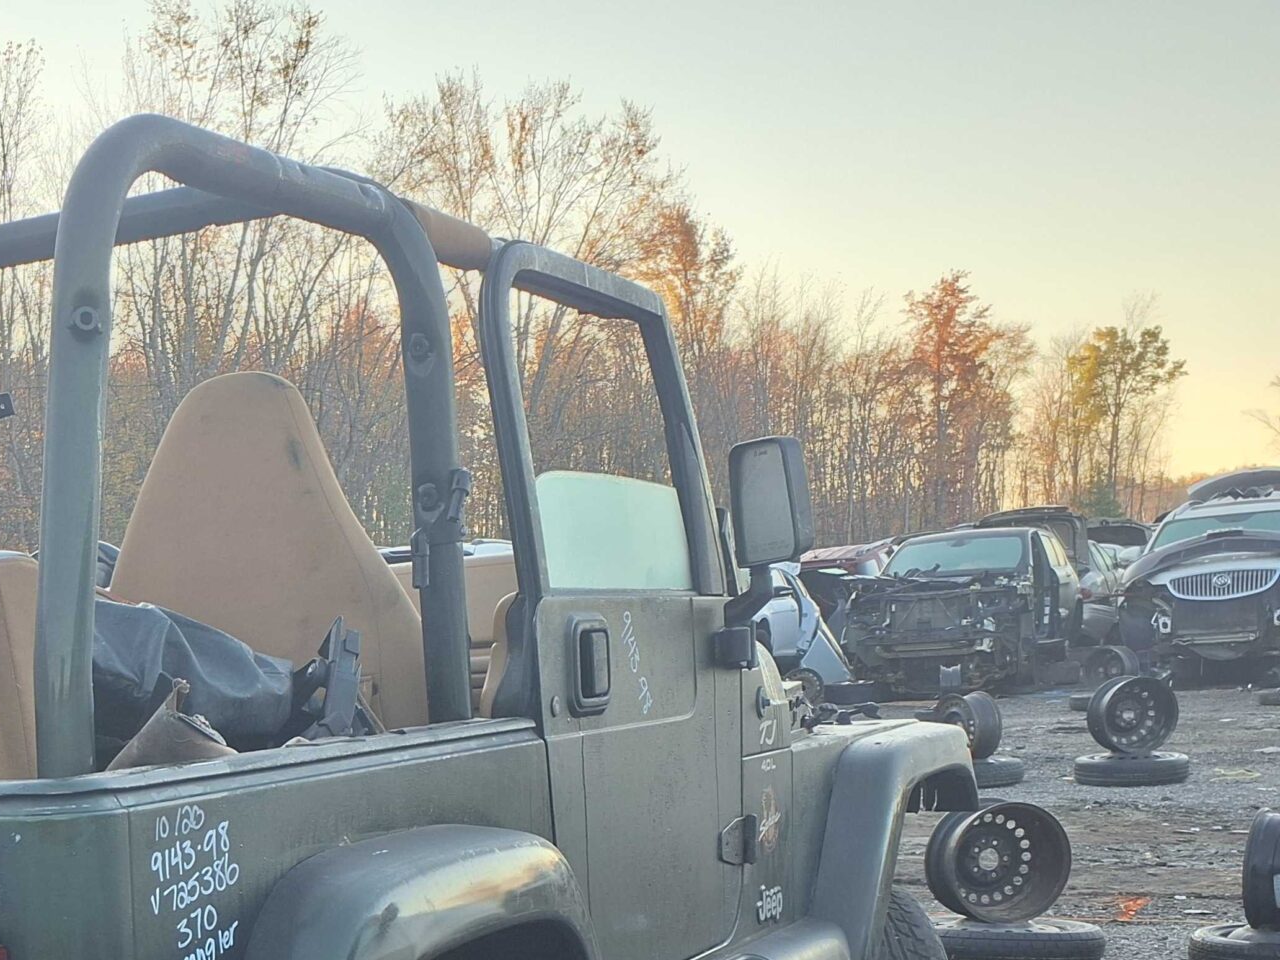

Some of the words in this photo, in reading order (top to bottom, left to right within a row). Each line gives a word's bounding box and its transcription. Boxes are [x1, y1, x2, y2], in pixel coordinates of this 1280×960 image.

[759, 719, 777, 745] TJ
[151, 820, 229, 881] 9143.98
[163, 853, 239, 911] 725386
[757, 885, 783, 922] Jeep
[177, 904, 217, 948] 370
